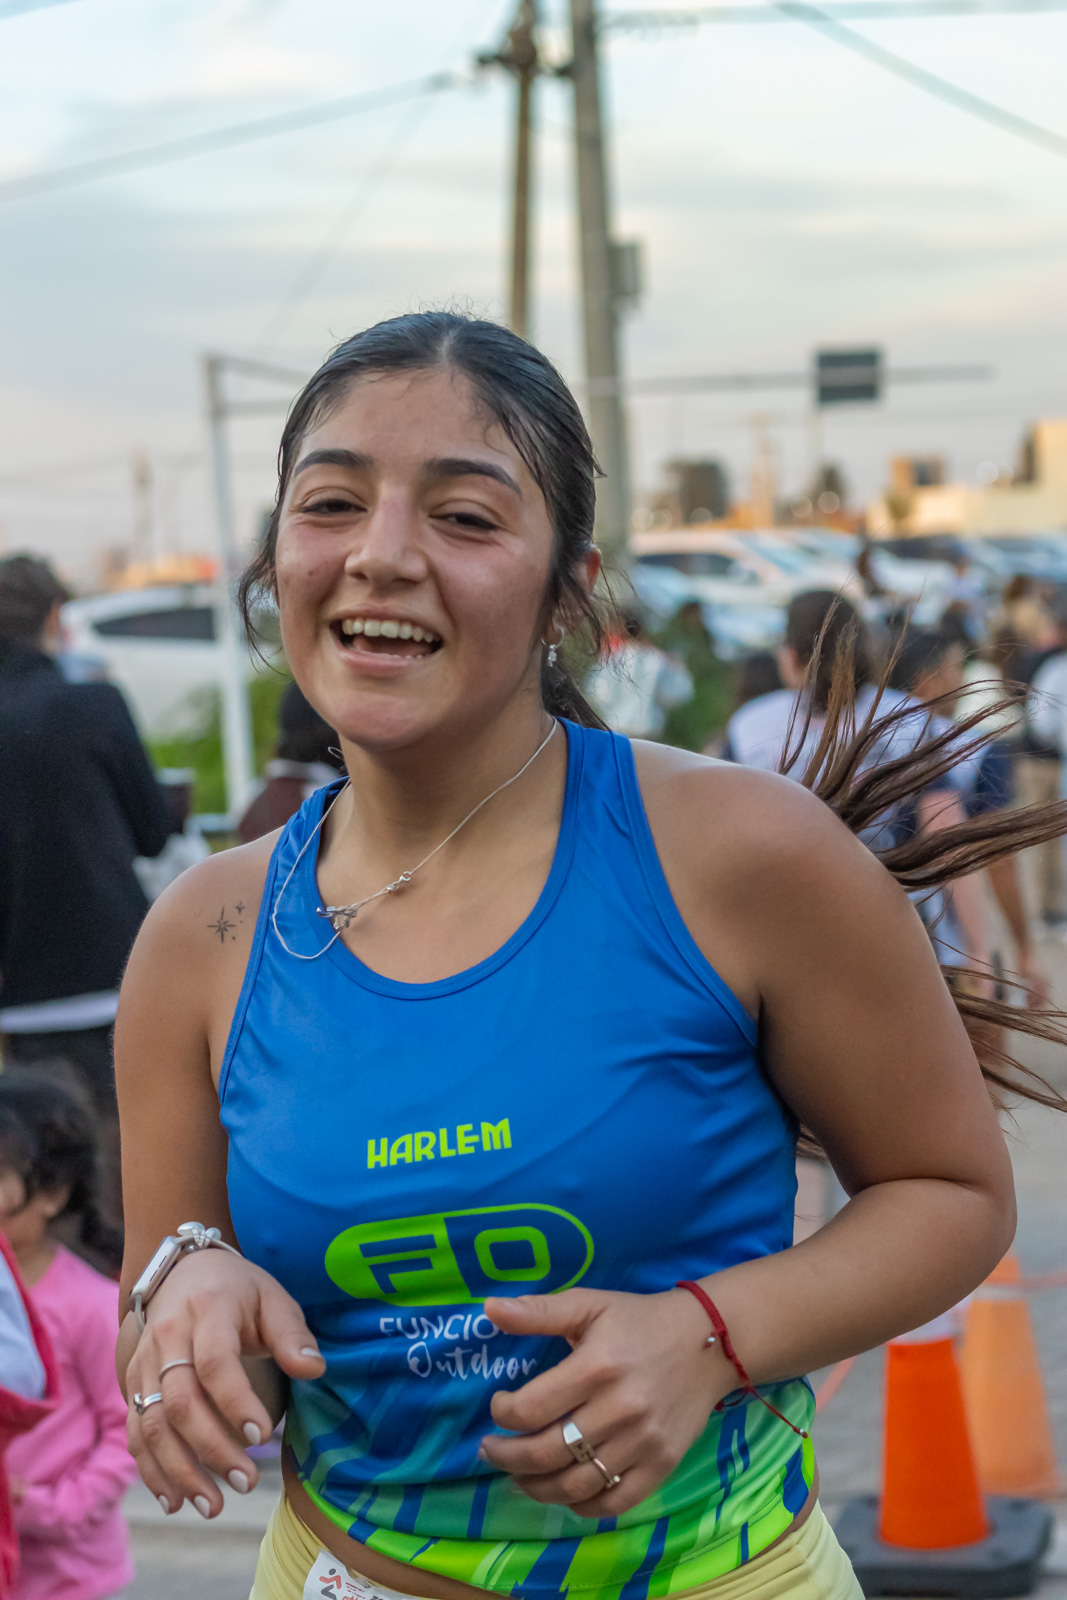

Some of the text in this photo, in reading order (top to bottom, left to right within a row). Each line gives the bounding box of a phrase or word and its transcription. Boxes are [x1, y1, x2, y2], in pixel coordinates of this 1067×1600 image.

[367, 1118, 513, 1169] HARLEM
[379, 1313, 509, 1341] FUNCIO
[407, 1341, 538, 1381] Outdoor
